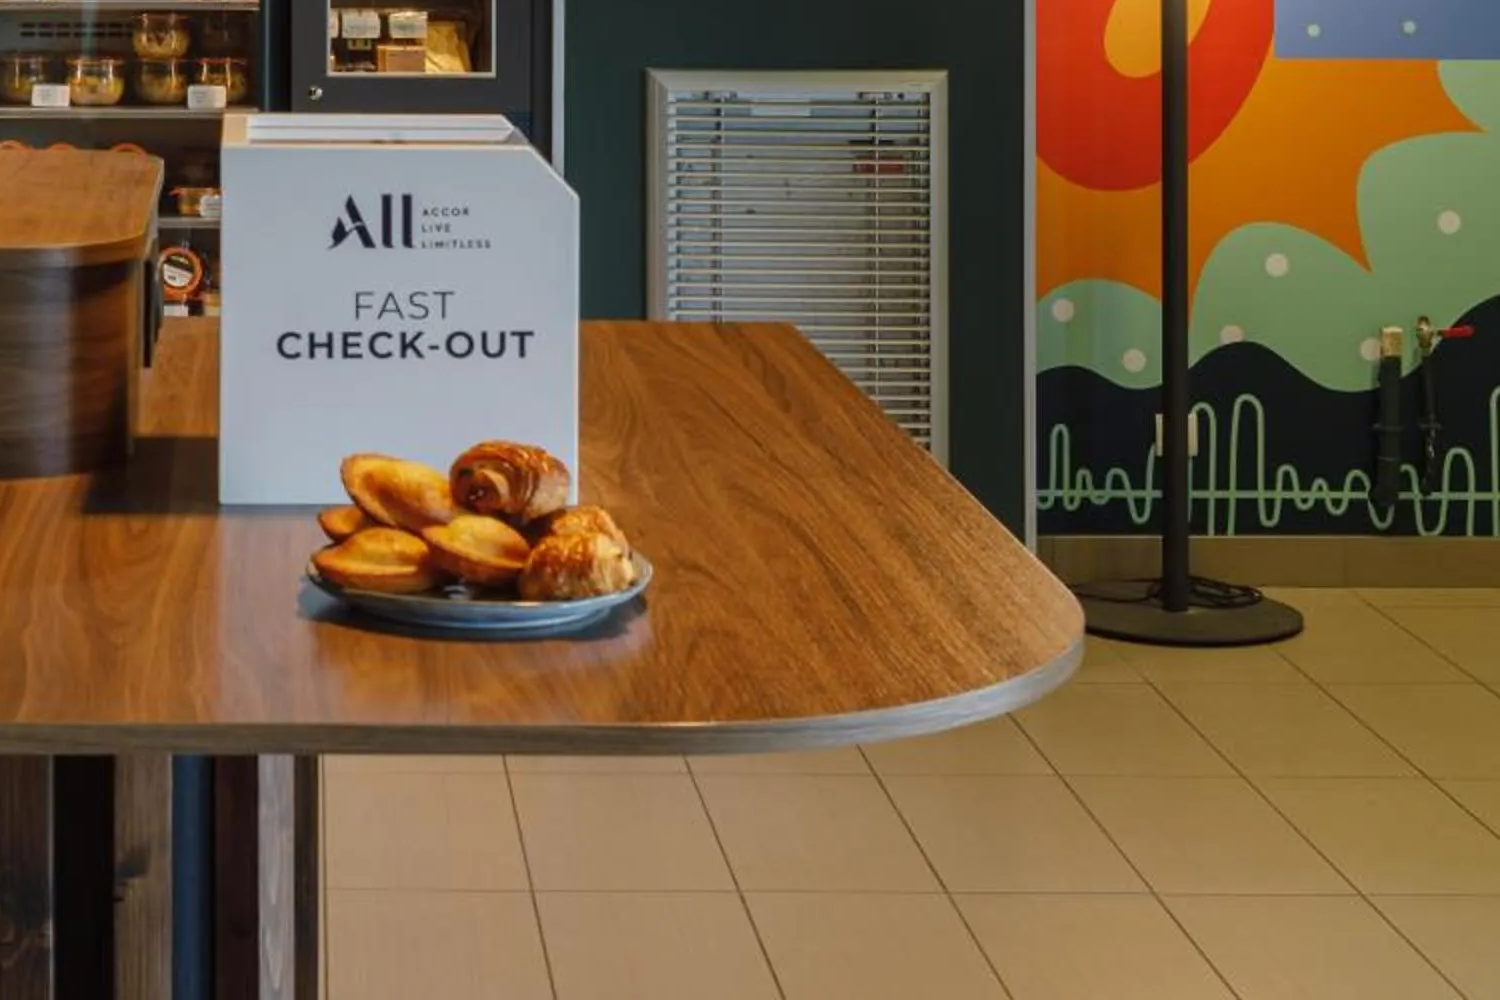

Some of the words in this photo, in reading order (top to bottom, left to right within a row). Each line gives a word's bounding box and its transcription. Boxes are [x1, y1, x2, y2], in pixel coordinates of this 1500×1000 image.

[421, 206, 470, 217] ACCOR
[421, 223, 451, 233] LIVE
[421, 239, 491, 249] LIMITLESS
[354, 291, 456, 320] FAST
[276, 331, 535, 360] CHECK-OUT
